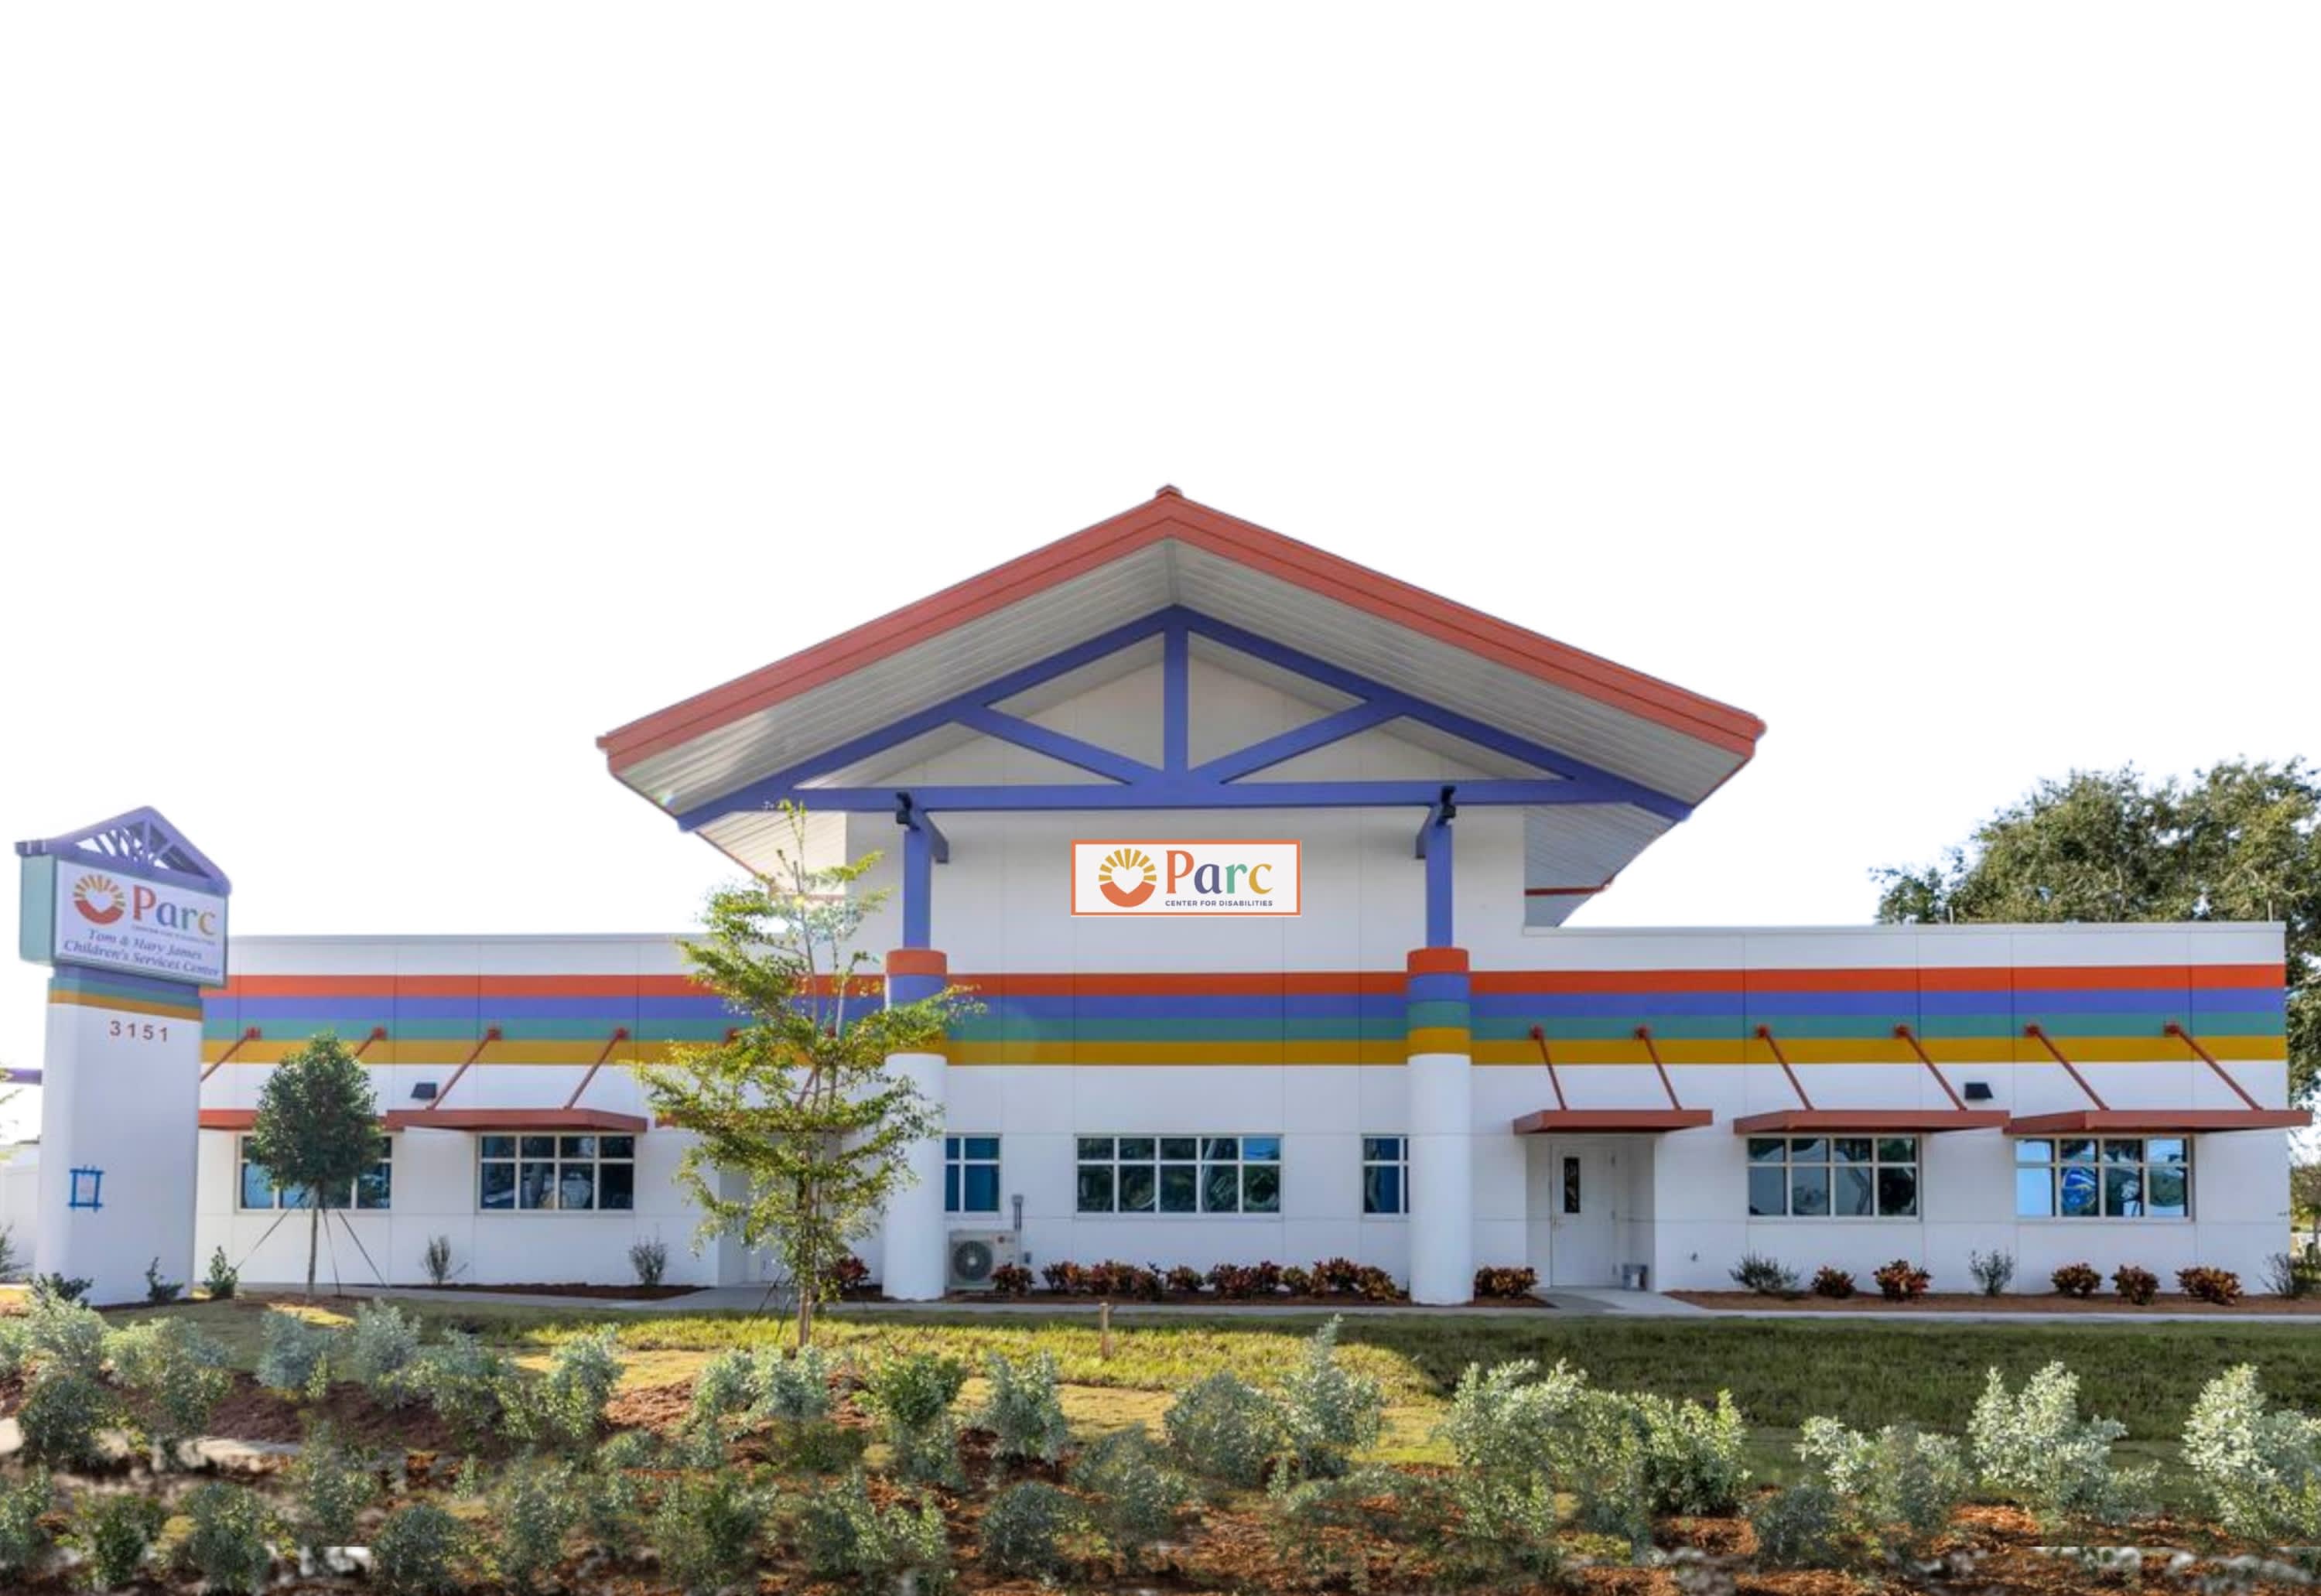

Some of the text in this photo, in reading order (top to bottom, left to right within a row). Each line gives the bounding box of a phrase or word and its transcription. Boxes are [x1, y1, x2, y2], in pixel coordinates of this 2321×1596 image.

[1165, 849, 1273, 894] Parc
[132, 885, 217, 937] Parc
[64, 940, 220, 977] Children's Services Center
[88, 929, 117, 942] Tom
[120, 936, 128, 946] &
[135, 939, 163, 955] Mary
[167, 944, 203, 960] James
[110, 1020, 168, 1042] 3151
